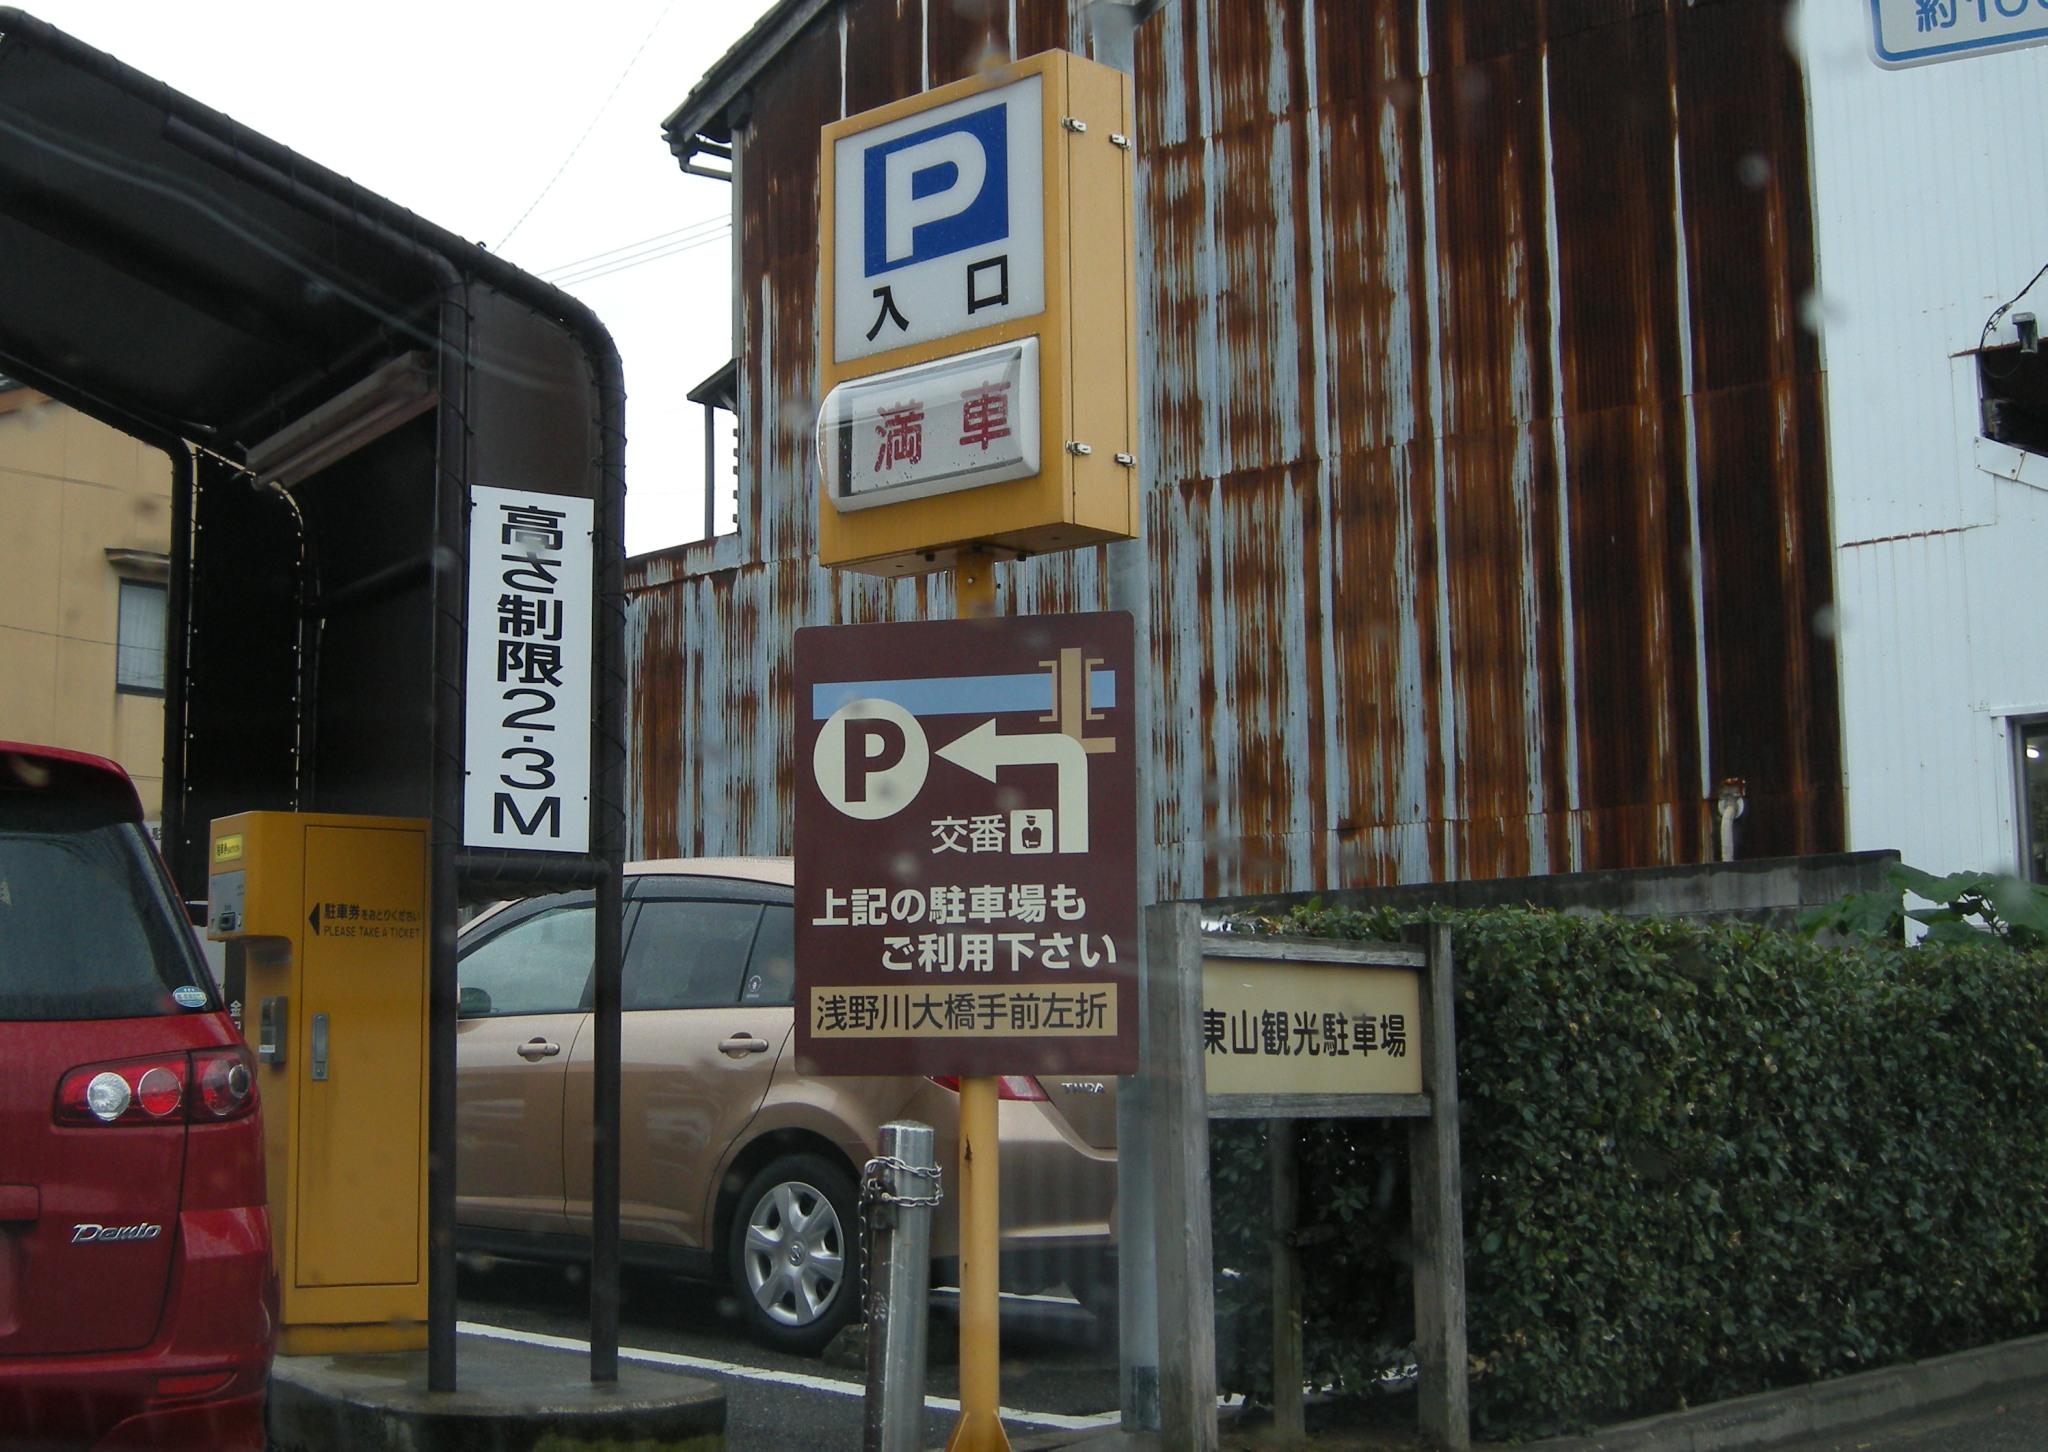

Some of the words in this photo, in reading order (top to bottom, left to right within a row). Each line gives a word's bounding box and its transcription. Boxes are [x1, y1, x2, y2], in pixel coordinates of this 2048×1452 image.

[885, 131, 987, 264] P
[844, 718, 906, 803] P
[930, 815, 1006, 854] 交番
[812, 884, 1087, 927] 上記の駐車場も
[324, 926, 356, 937] PLEASE
[359, 927, 379, 937] TAKE
[382, 927, 388, 937] A
[390, 927, 421, 938] TICKET
[882, 932, 1117, 973] ご利用下さい
[816, 991, 1108, 1031] 浅野川大橋手前左折
[1203, 1008, 1406, 1057] 東山観光駐車場
[71, 1222, 162, 1244] Demio
